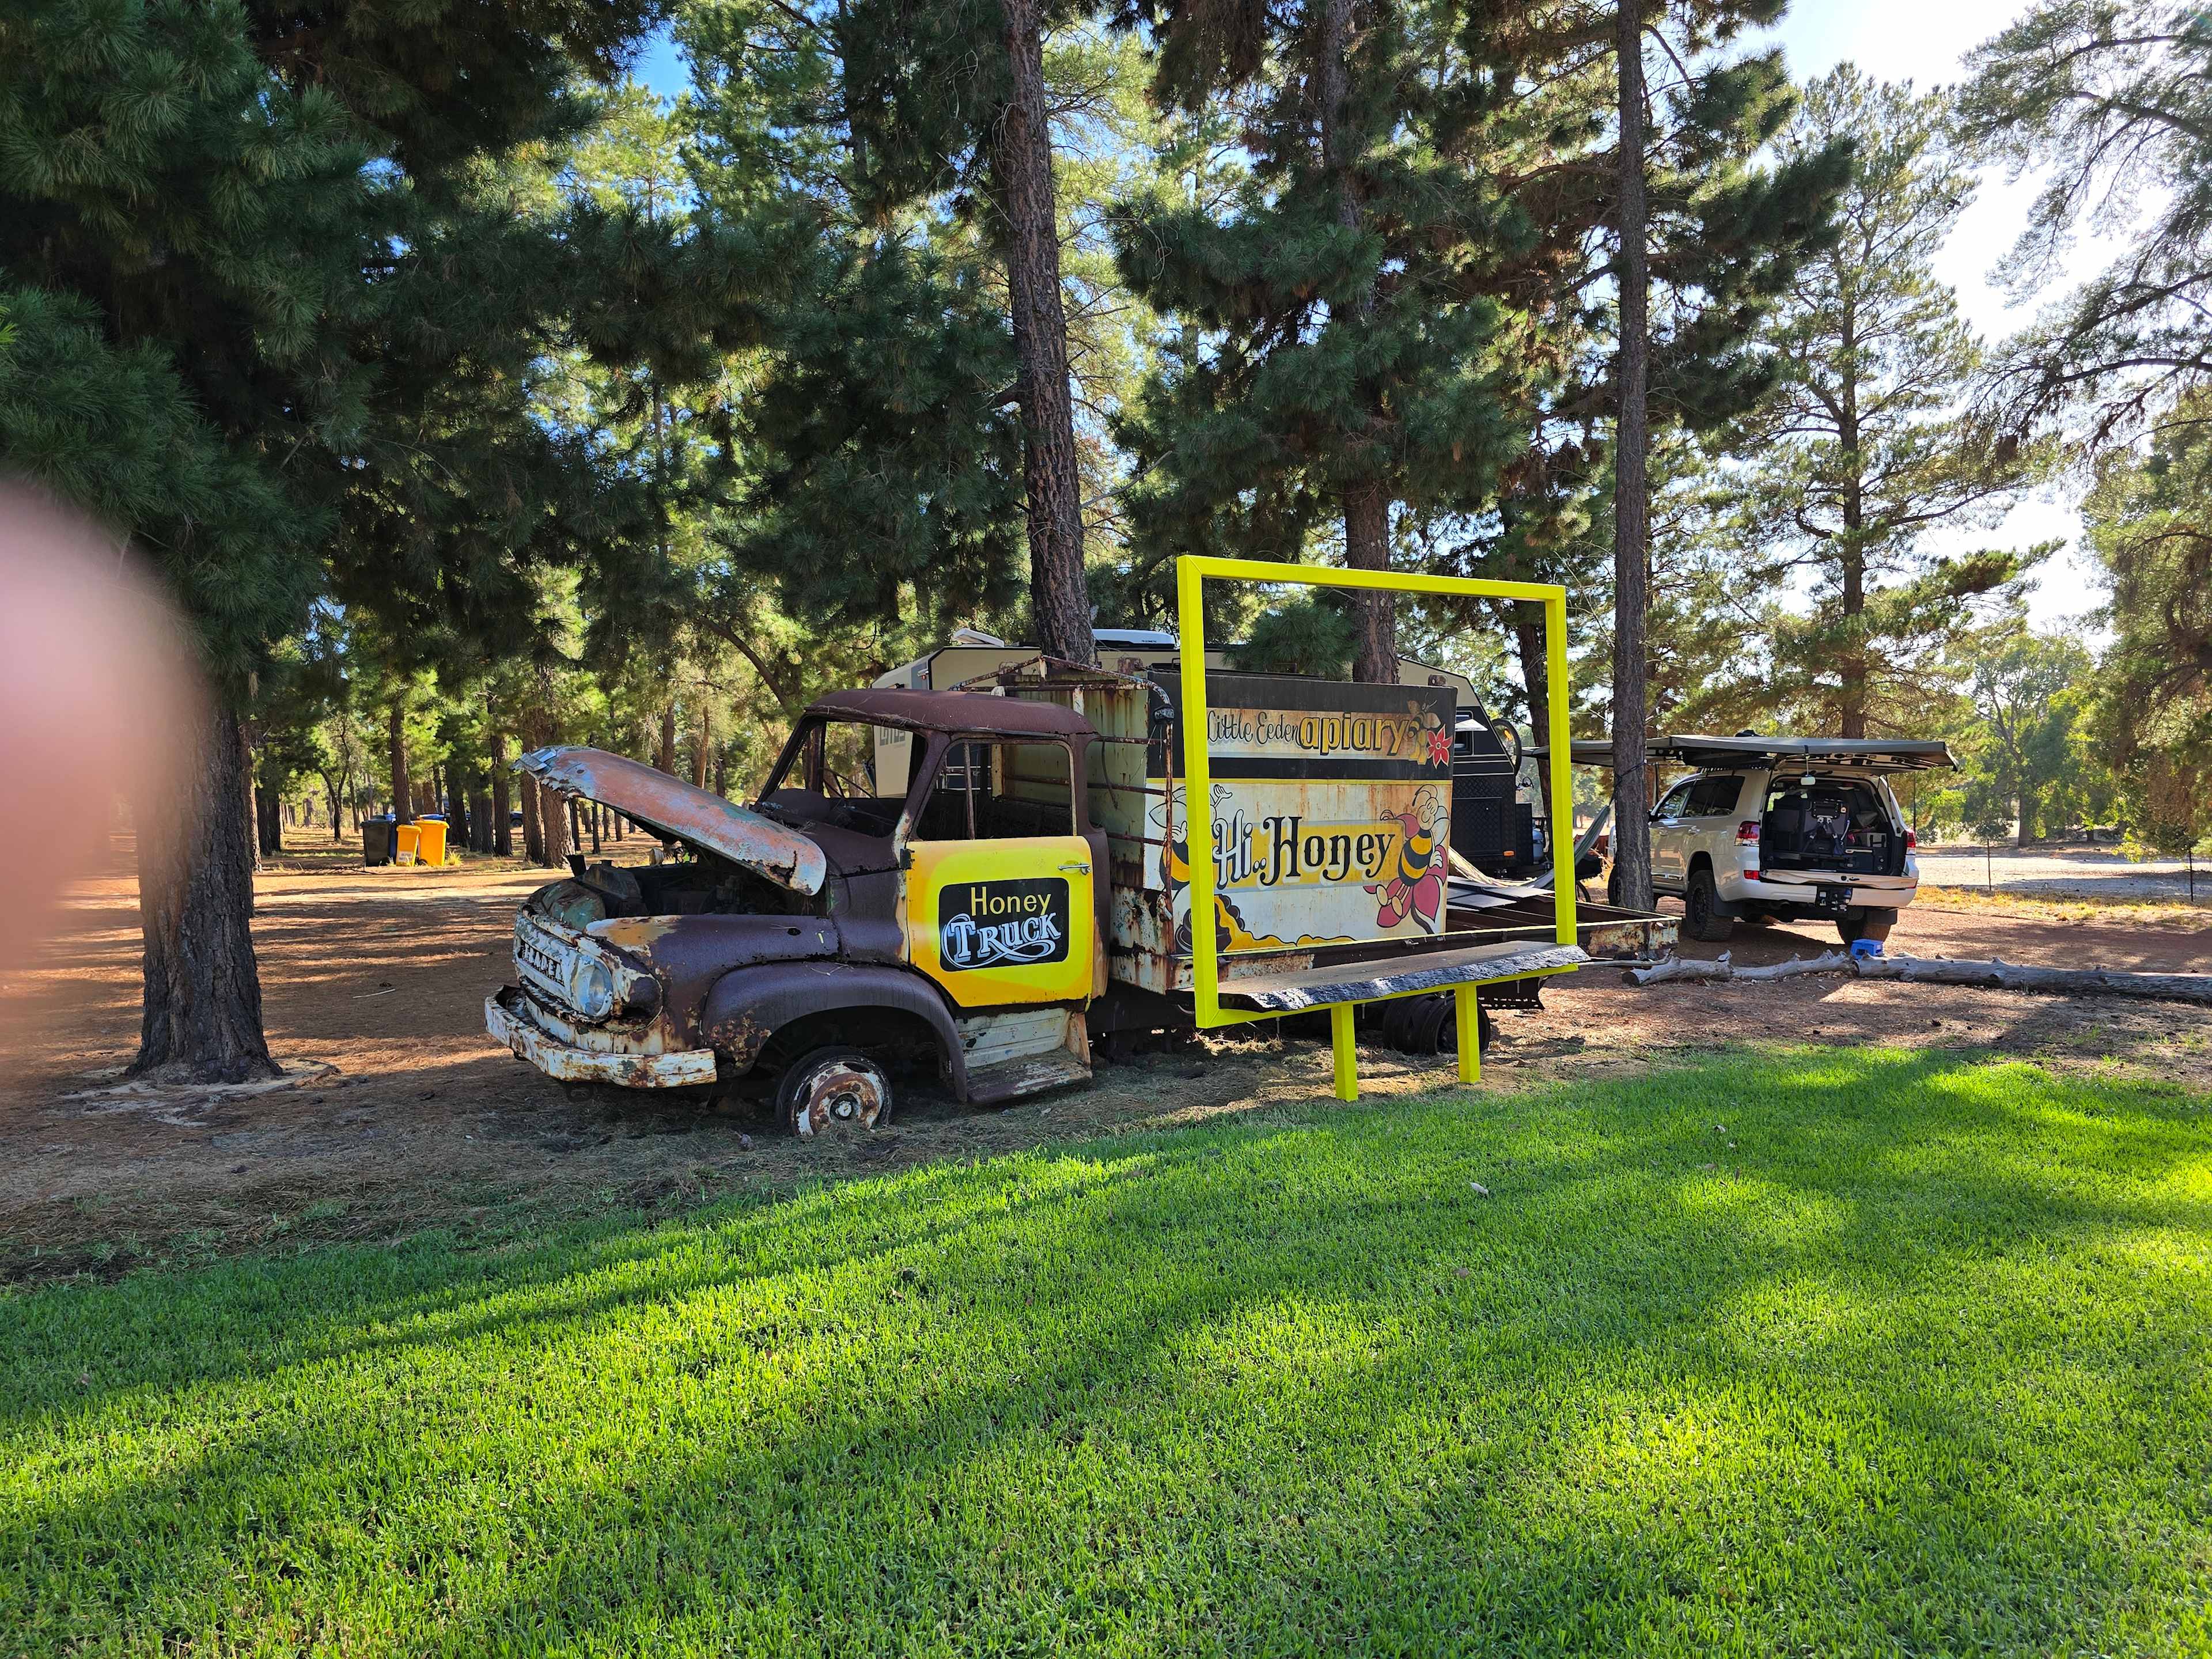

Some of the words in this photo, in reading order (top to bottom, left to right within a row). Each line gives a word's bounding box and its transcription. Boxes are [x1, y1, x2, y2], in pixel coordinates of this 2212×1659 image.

[1207, 710, 1253, 743] Little
[1298, 712, 1410, 756] apiary
[1259, 816, 1396, 887] Honey
[970, 886, 1052, 916] Honey
[941, 912, 1062, 969] TRUCK
